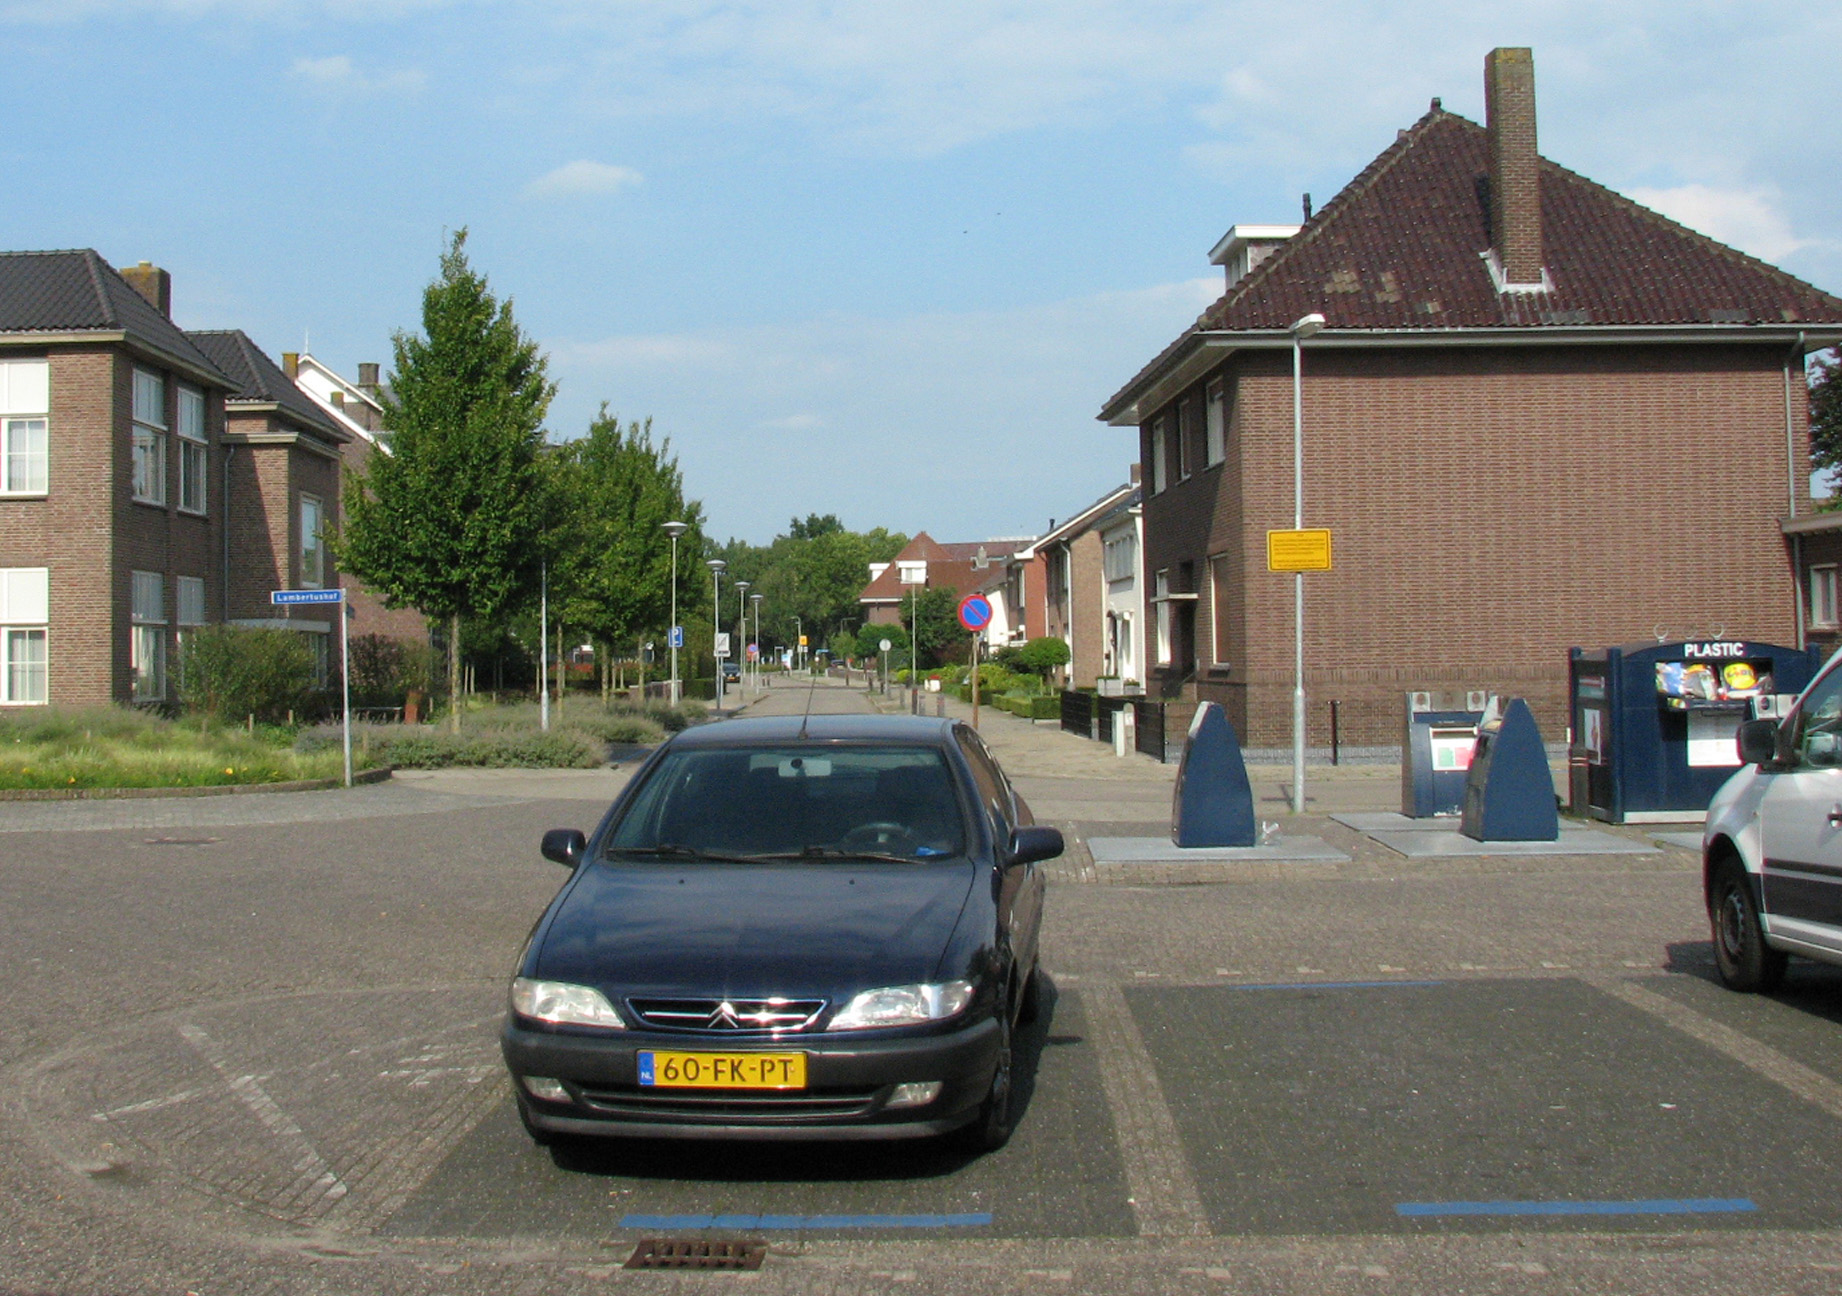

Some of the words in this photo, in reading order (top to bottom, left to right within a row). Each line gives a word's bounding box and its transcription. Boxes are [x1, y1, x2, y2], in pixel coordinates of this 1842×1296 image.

[276, 592, 338, 601] Lambertushof
[1684, 642, 1744, 657] PLASTIC
[641, 1071, 653, 1080] NL
[663, 1057, 793, 1082] 60-FK-PT
